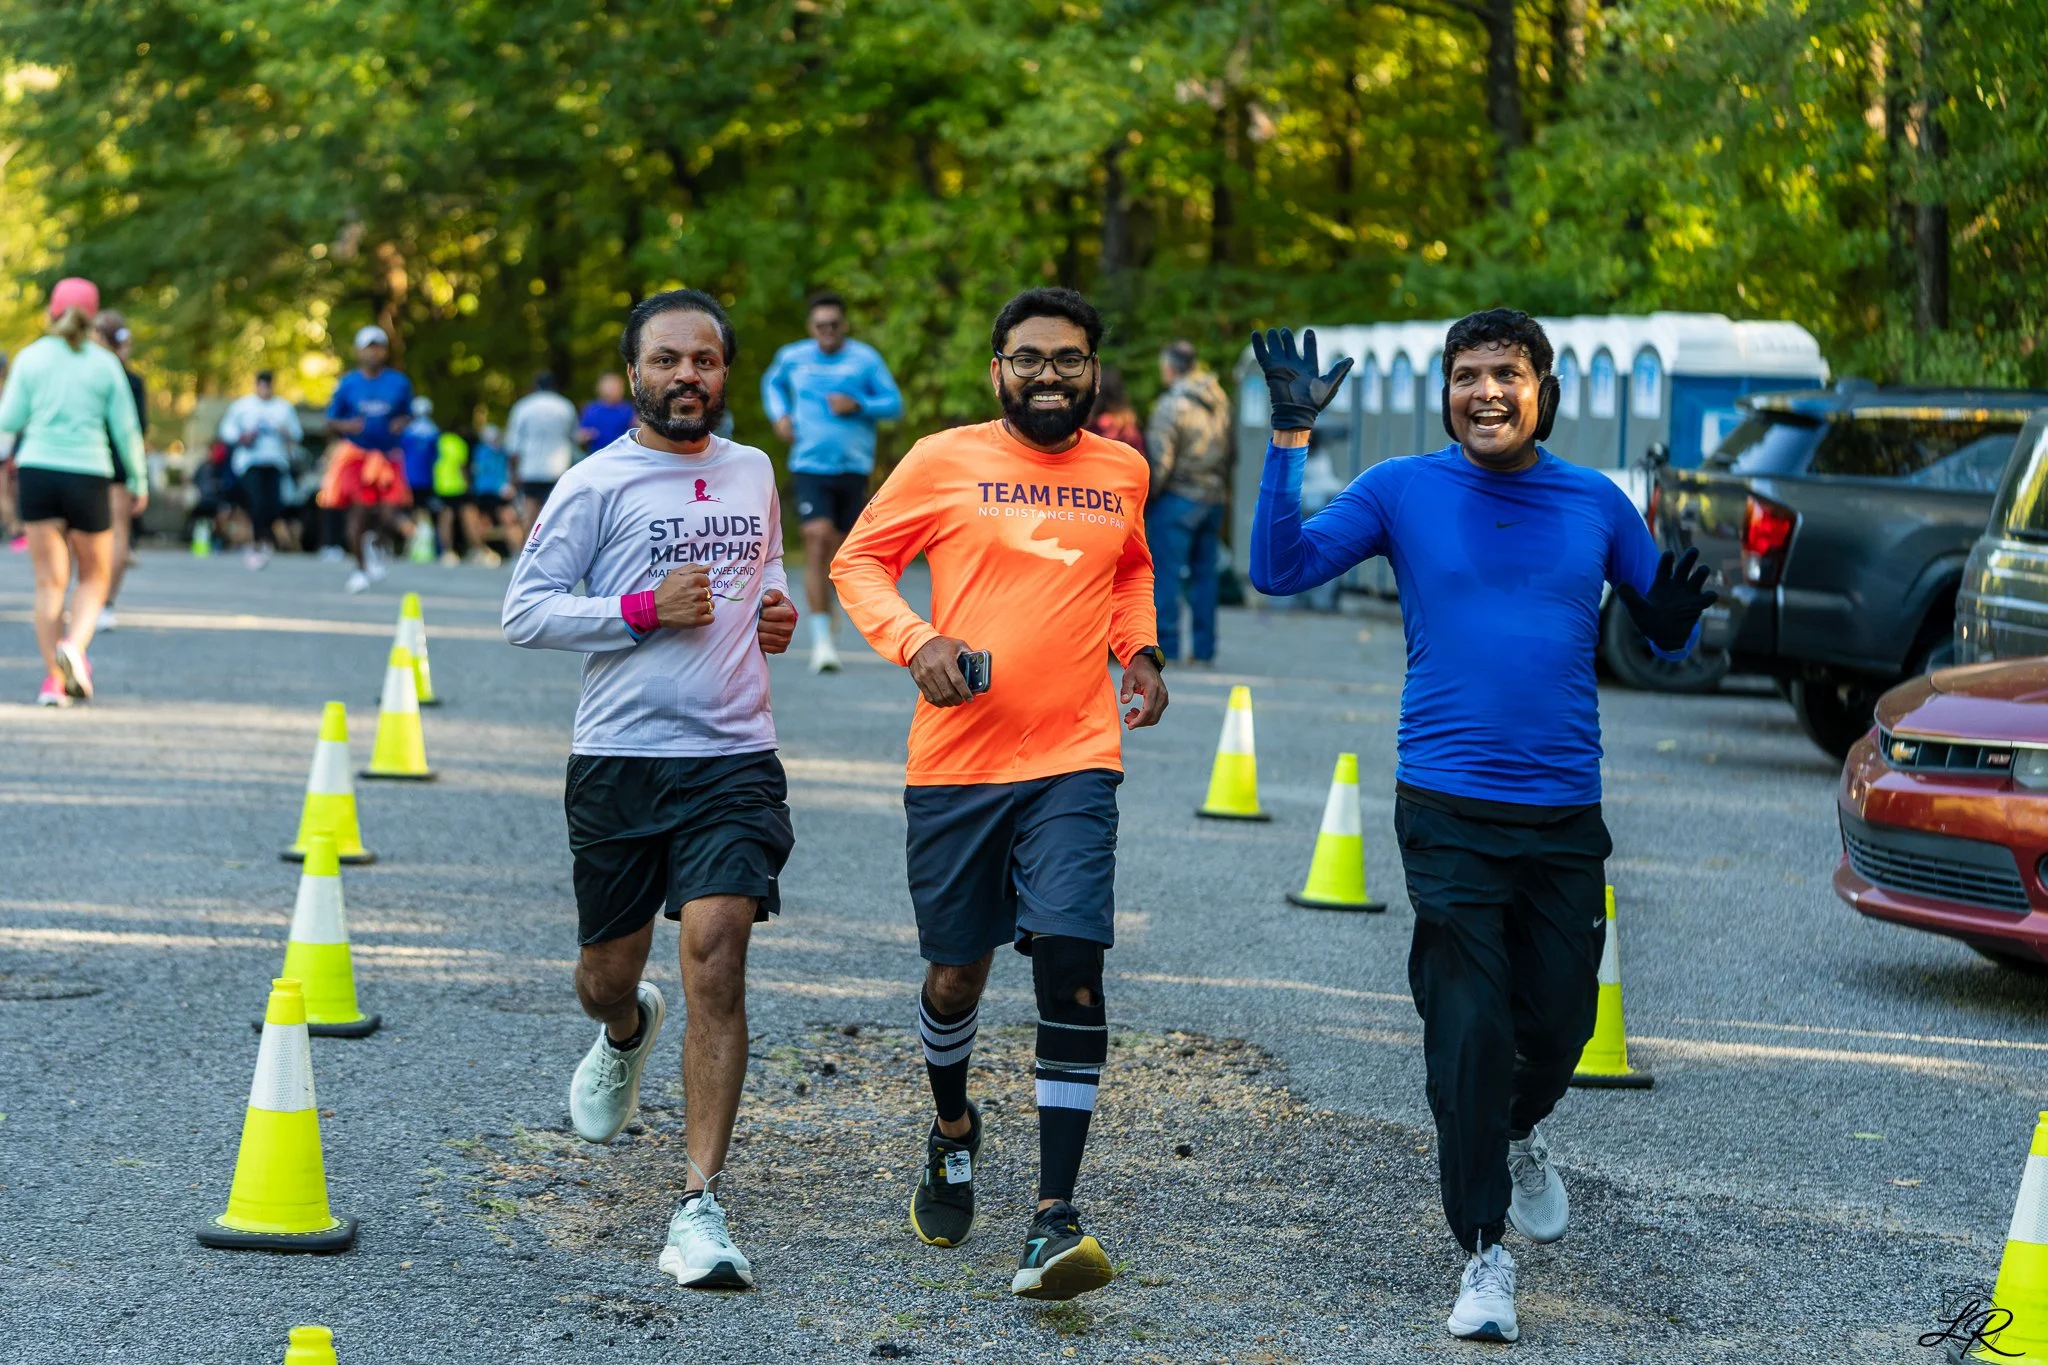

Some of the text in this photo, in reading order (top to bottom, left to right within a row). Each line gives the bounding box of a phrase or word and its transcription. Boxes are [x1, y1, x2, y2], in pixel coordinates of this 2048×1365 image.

[978, 482, 1125, 517] TEAM FEDEX
[649, 515, 763, 541] ST. JUDE
[978, 506, 1125, 530] NO DISTANCE TOO FAR
[650, 541, 762, 566] MEMPHIS
[712, 566, 756, 576] WEEKEND
